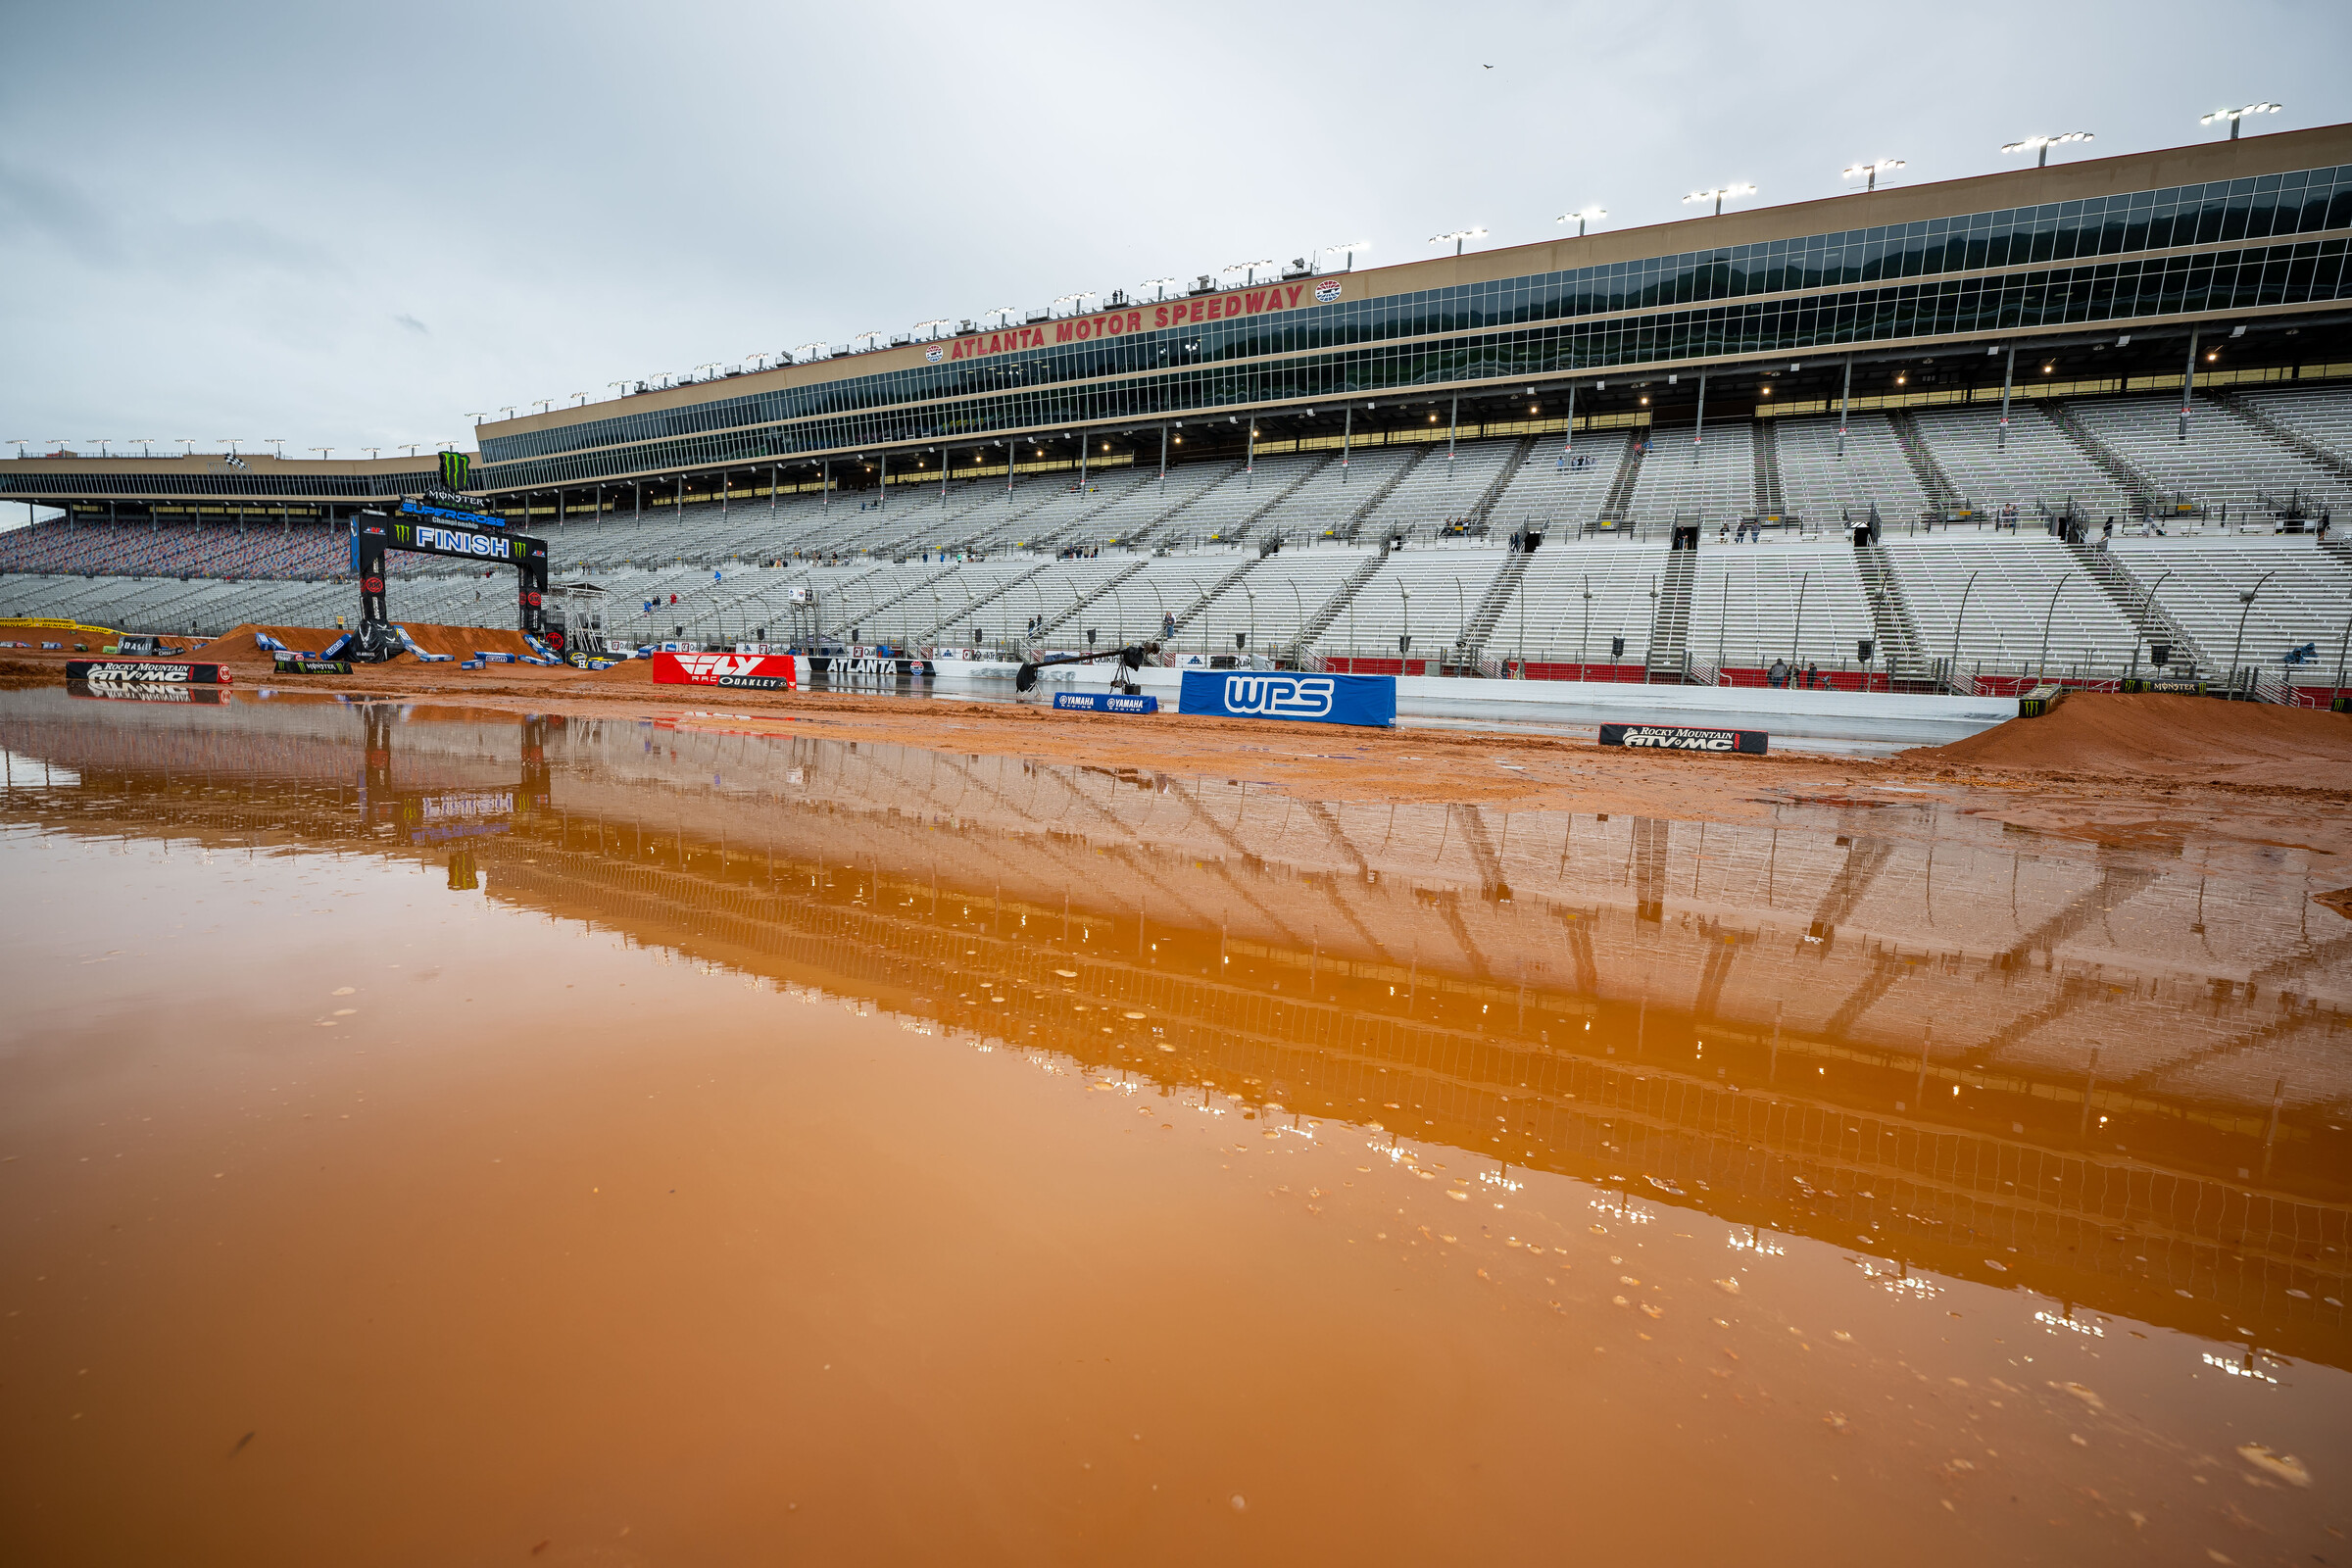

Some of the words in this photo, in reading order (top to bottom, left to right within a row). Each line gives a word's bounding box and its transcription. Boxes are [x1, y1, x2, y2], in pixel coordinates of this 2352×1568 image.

[951, 327, 1045, 360] ATLANTA
[1055, 312, 1142, 342] MOTOR
[1154, 284, 1304, 327] SPEEDWAY
[207, 462, 230, 472] CLUB
[428, 490, 485, 507] MONSTER
[438, 501, 477, 511] ENERGY
[401, 503, 506, 527] SUPERCROSS
[432, 516, 479, 529] Championship
[416, 525, 510, 559] FINISH
[104, 662, 135, 671] ROCKY
[137, 662, 189, 672] MOUNTAIN
[306, 662, 336, 670] MONSTER
[673, 655, 765, 675] FLY
[826, 659, 898, 674] ATLANTA
[734, 678, 777, 687] OAKLEY
[2154, 682, 2196, 692] MONSTER
[1067, 696, 1094, 706] YAMAHA
[1115, 699, 1144, 709] YAMAHA
[1225, 676, 1334, 717] WPS
[1641, 727, 1675, 736] ROCKY
[1675, 728, 1734, 740] MOUNTAIN
